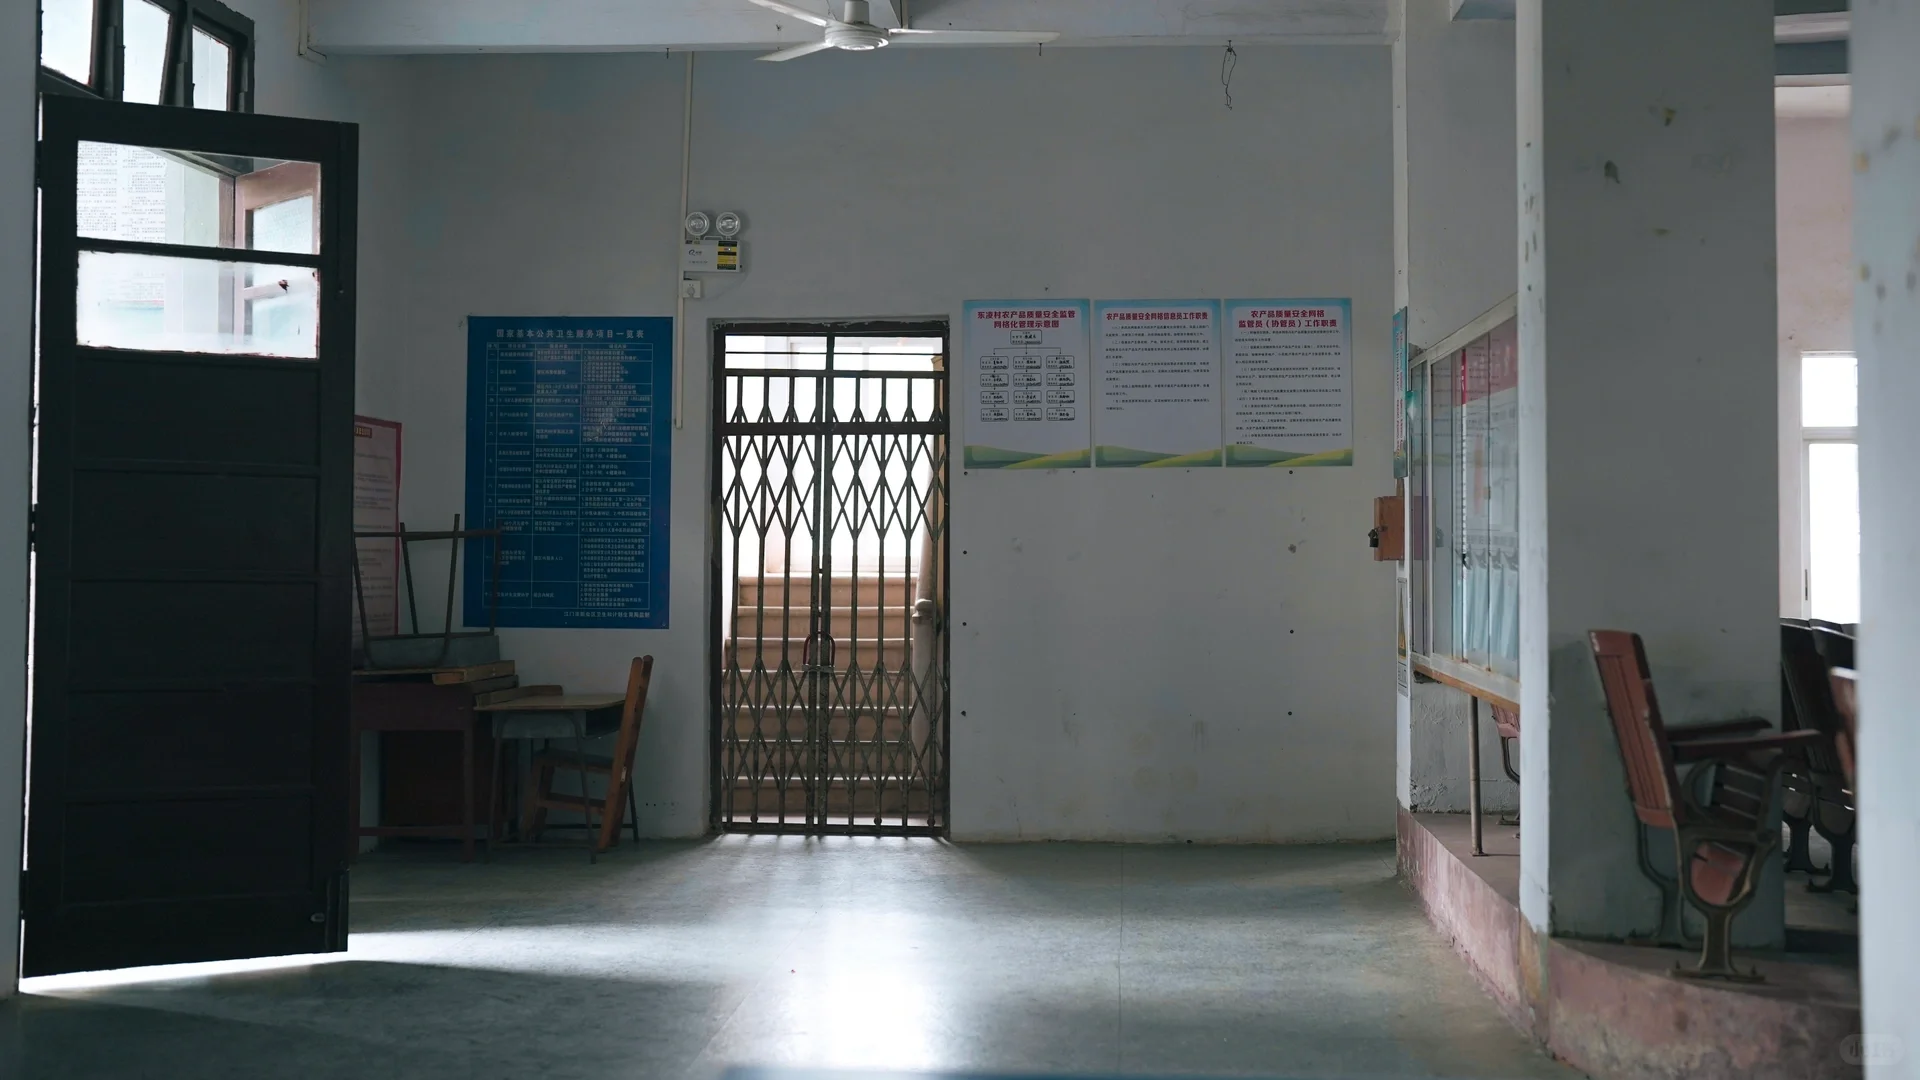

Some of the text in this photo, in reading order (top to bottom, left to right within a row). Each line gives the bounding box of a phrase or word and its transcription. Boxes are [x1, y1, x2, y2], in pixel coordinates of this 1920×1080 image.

[1106, 312, 1209, 321] 农产品质量安全网格信息员工作职责
[1250, 310, 1325, 318] 农产品质量安全网格
[993, 320, 1060, 329] 网格化管理示意图
[496, 329, 645, 339] 国家基本公共卫生服务项目一览表
